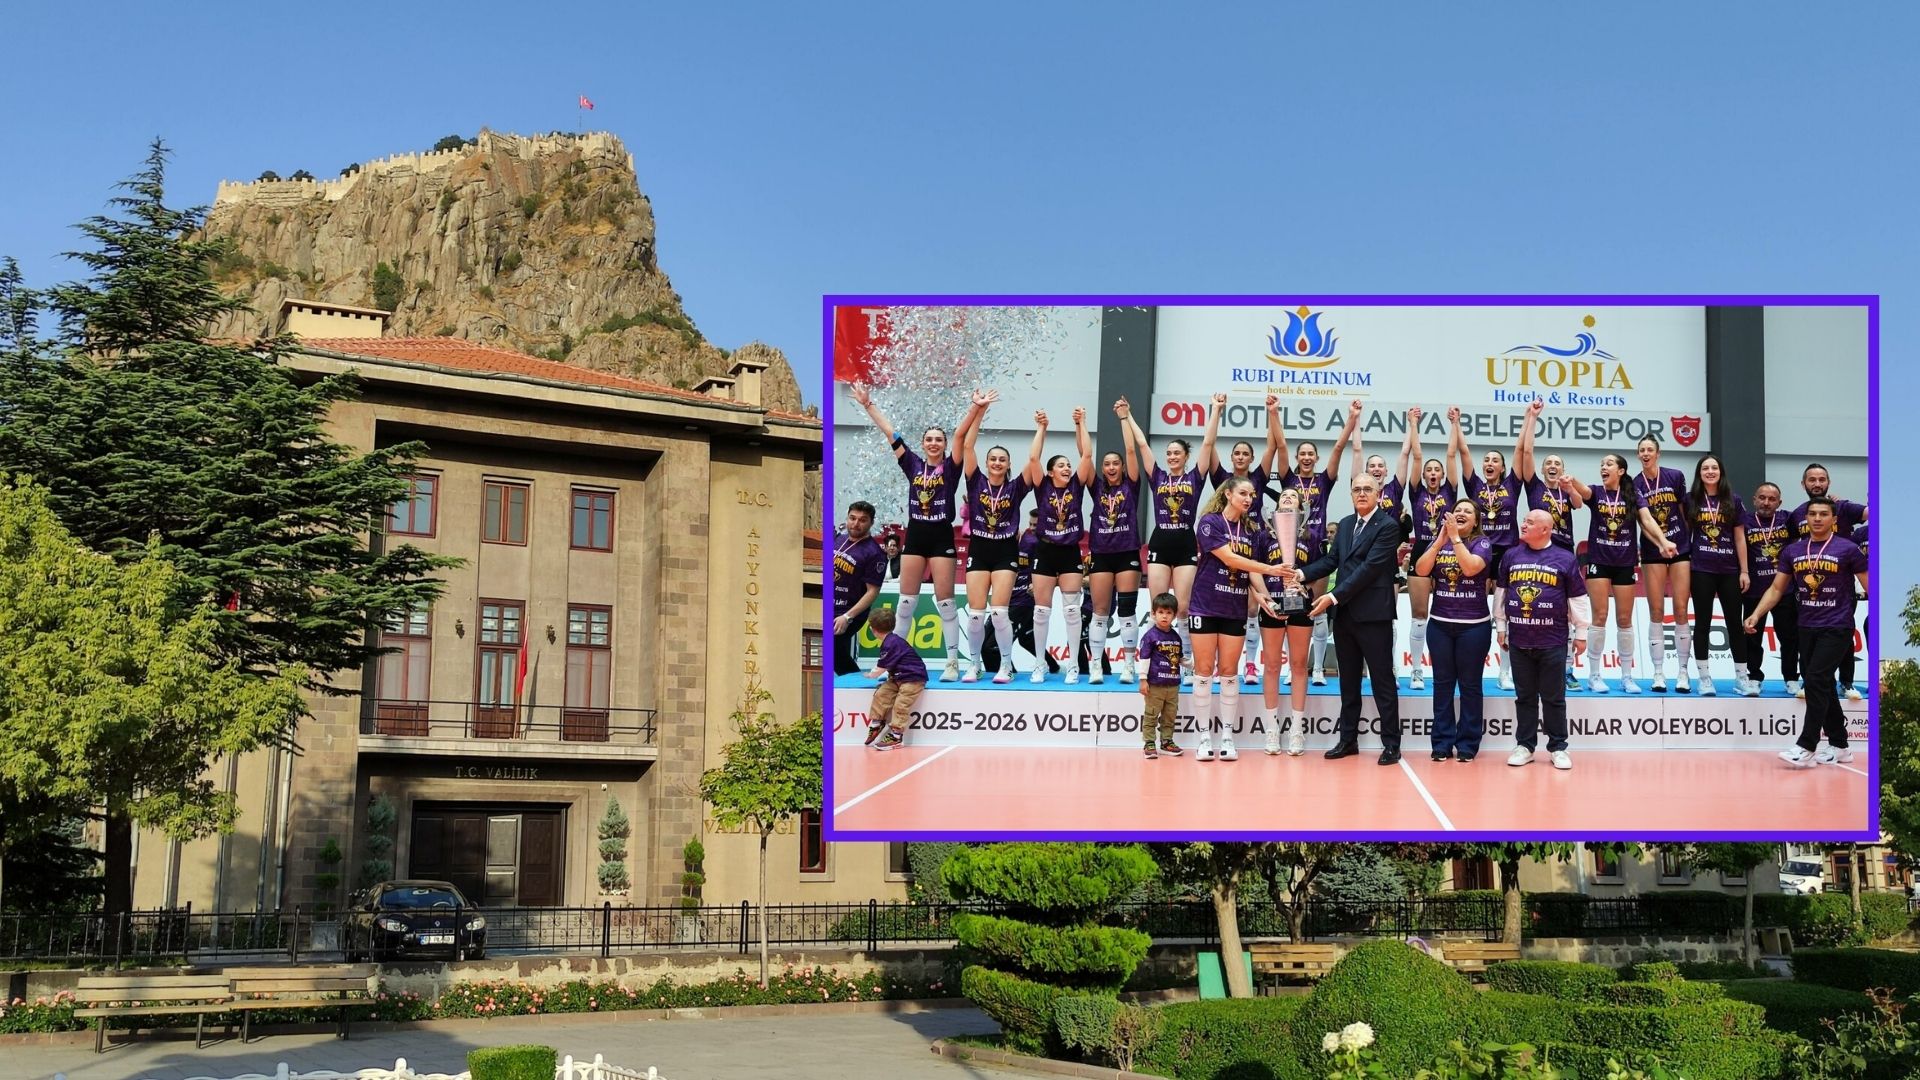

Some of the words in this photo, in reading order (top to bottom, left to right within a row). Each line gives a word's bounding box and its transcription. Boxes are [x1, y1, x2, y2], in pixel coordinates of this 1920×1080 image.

[1232, 368, 1274, 383] RUBI
[1280, 370, 1372, 386] PLATINUM
[1484, 357, 1634, 390] UTOPIA
[1267, 384, 1294, 395] hotels
[1296, 386, 1305, 395] &
[1308, 387, 1338, 396] resorts
[1494, 389, 1543, 403] Hotels
[1549, 391, 1562, 404] &
[1568, 392, 1625, 406] Resorts
[1326, 408, 1446, 436] AANYA
[736, 489, 773, 508] T.C.
[1188, 614, 1203, 629] 19
[908, 711, 1028, 731] 2025-2026
[1357, 717, 1434, 736] COFEE
[1628, 718, 1734, 735] VOLEYBOL
[1739, 718, 1753, 735] 1.
[1759, 714, 1796, 736] LİGİ
